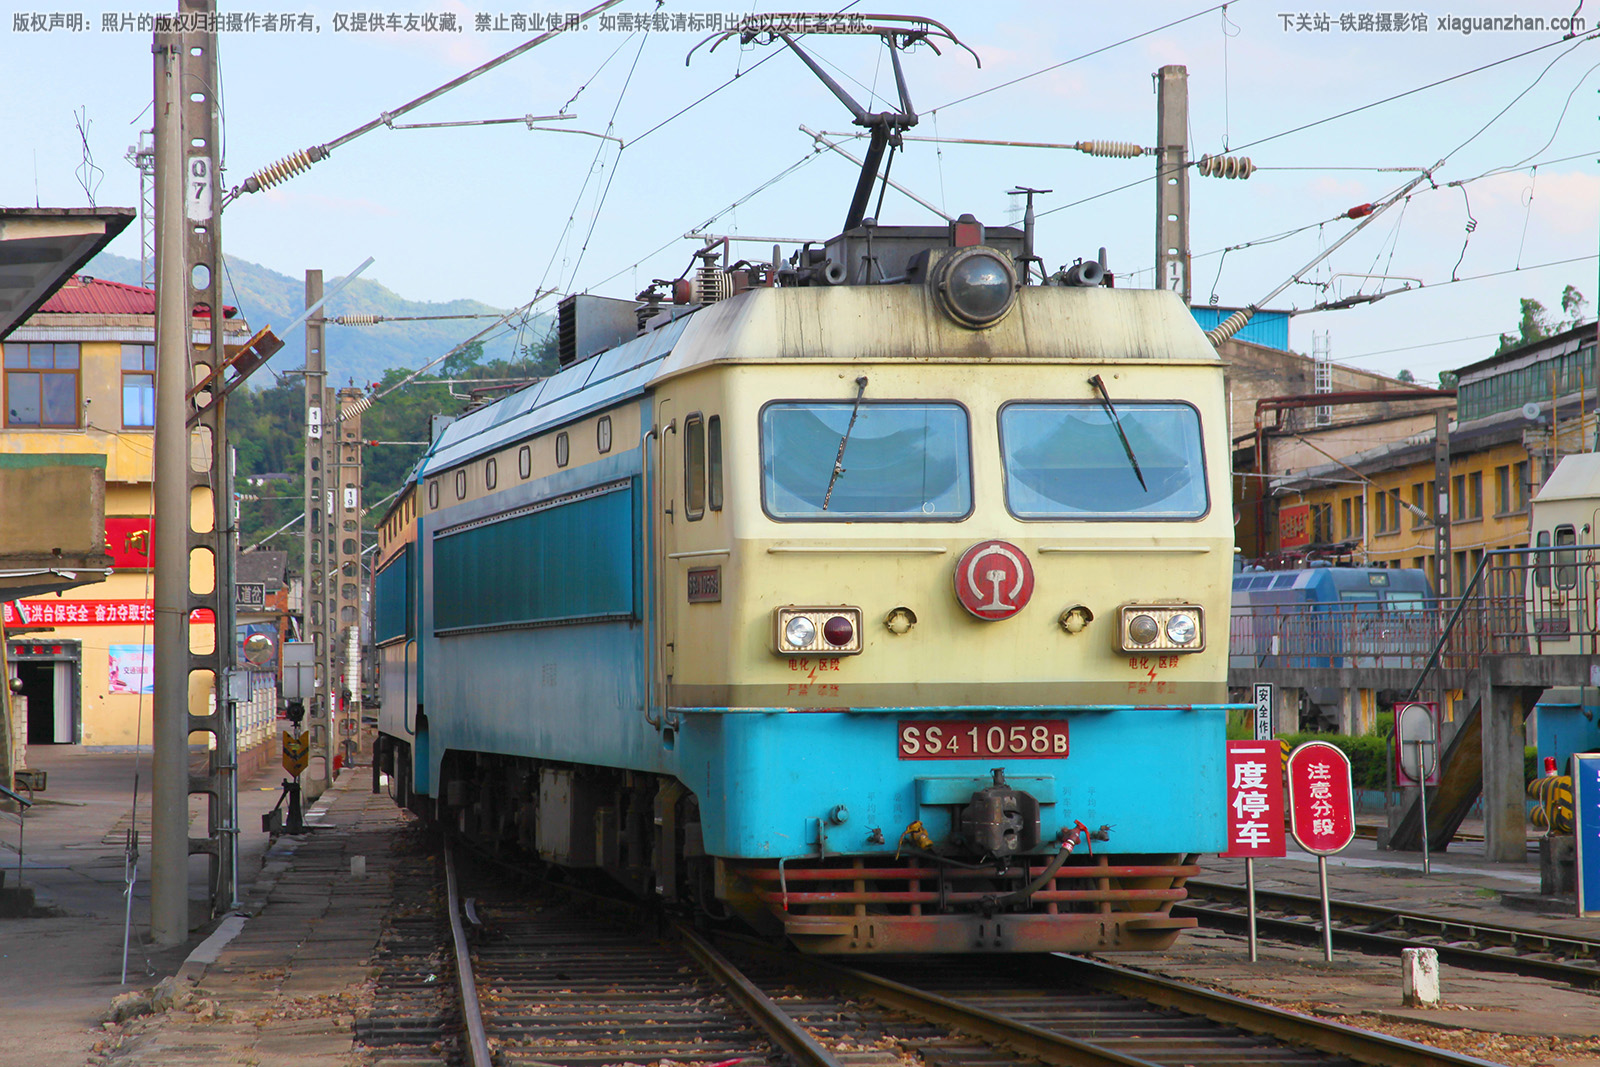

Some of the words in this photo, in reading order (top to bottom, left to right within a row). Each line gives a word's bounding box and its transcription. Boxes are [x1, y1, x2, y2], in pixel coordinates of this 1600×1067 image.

[1170, 262, 1180, 290] 17
[312, 410, 320, 434] 18
[346, 491, 353, 508] 19
[95, 604, 154, 622] 奋力夺取安
[788, 657, 810, 671] 电化
[819, 657, 840, 671] 区段
[1129, 656, 1149, 670] 电化
[1158, 655, 1179, 669] 区段
[1230, 748, 1271, 849] 一度停车
[1307, 762, 1336, 836] 注意分段
